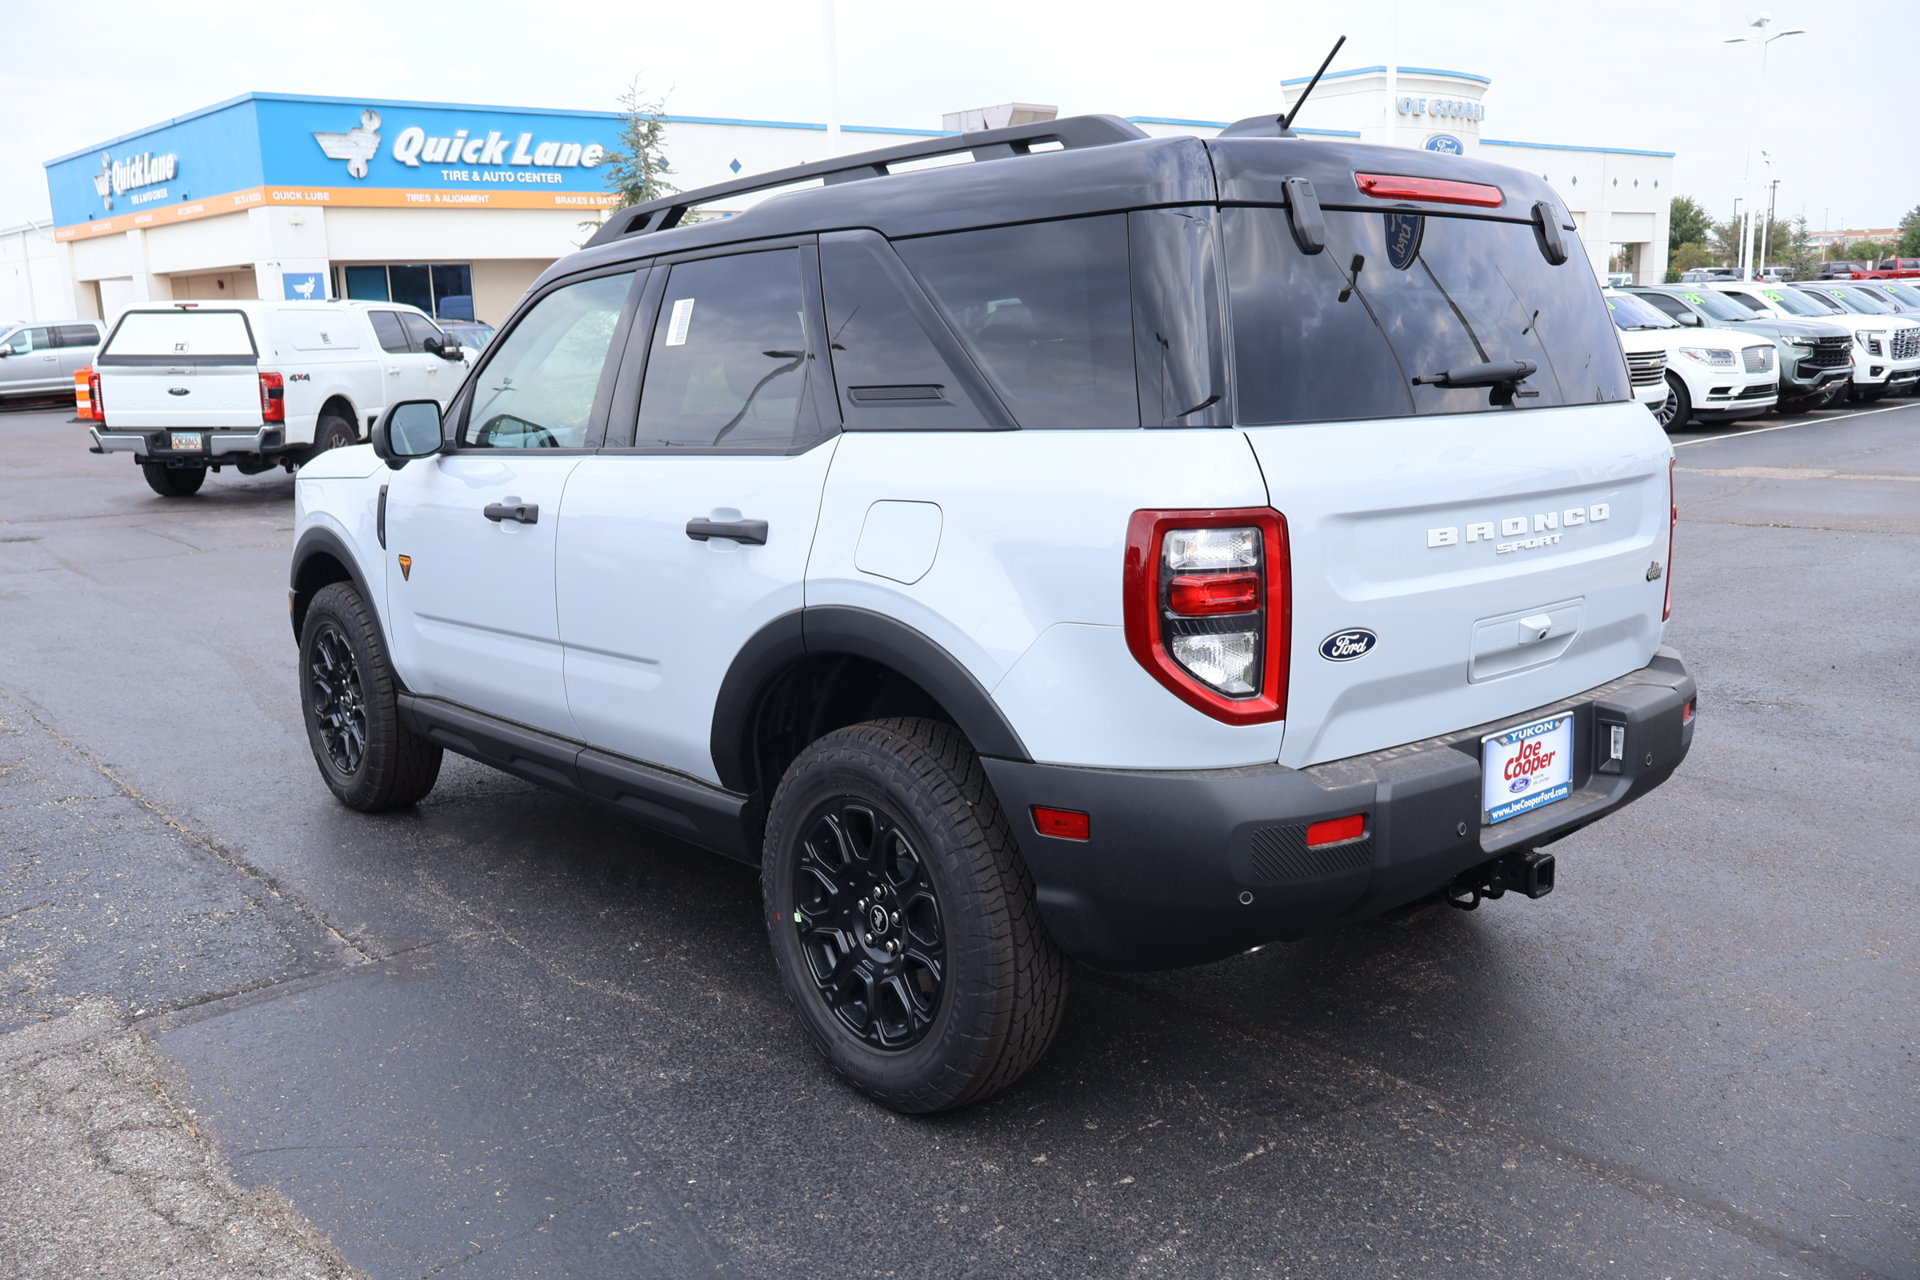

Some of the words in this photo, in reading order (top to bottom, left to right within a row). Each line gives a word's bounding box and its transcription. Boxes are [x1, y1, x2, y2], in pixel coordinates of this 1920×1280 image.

[1396, 97, 1427, 116] OE
[392, 126, 512, 167] Quick
[508, 132, 604, 168] Lane
[112, 155, 144, 196] Quick
[143, 152, 178, 186] Lane
[441, 170, 469, 182] TIRE
[472, 171, 480, 182] &
[483, 171, 515, 183] AUTO
[517, 172, 562, 184] CENTER
[272, 191, 303, 201] QUICK
[304, 191, 330, 201] LUBE
[405, 193, 431, 203] TIRES
[434, 194, 441, 203] &
[442, 194, 490, 204] ALIGNMENT
[555, 196, 588, 205] BRAKES
[589, 196, 596, 205] &
[1426, 503, 1610, 548] BRONCO
[1496, 533, 1563, 554] SPORT
[1331, 634, 1368, 657] Ford
[1511, 721, 1554, 742] YUKON
[1515, 739, 1542, 762] Joe
[1504, 750, 1556, 780] Cooper
[1491, 786, 1568, 819] www.JoeCooperFord.com
